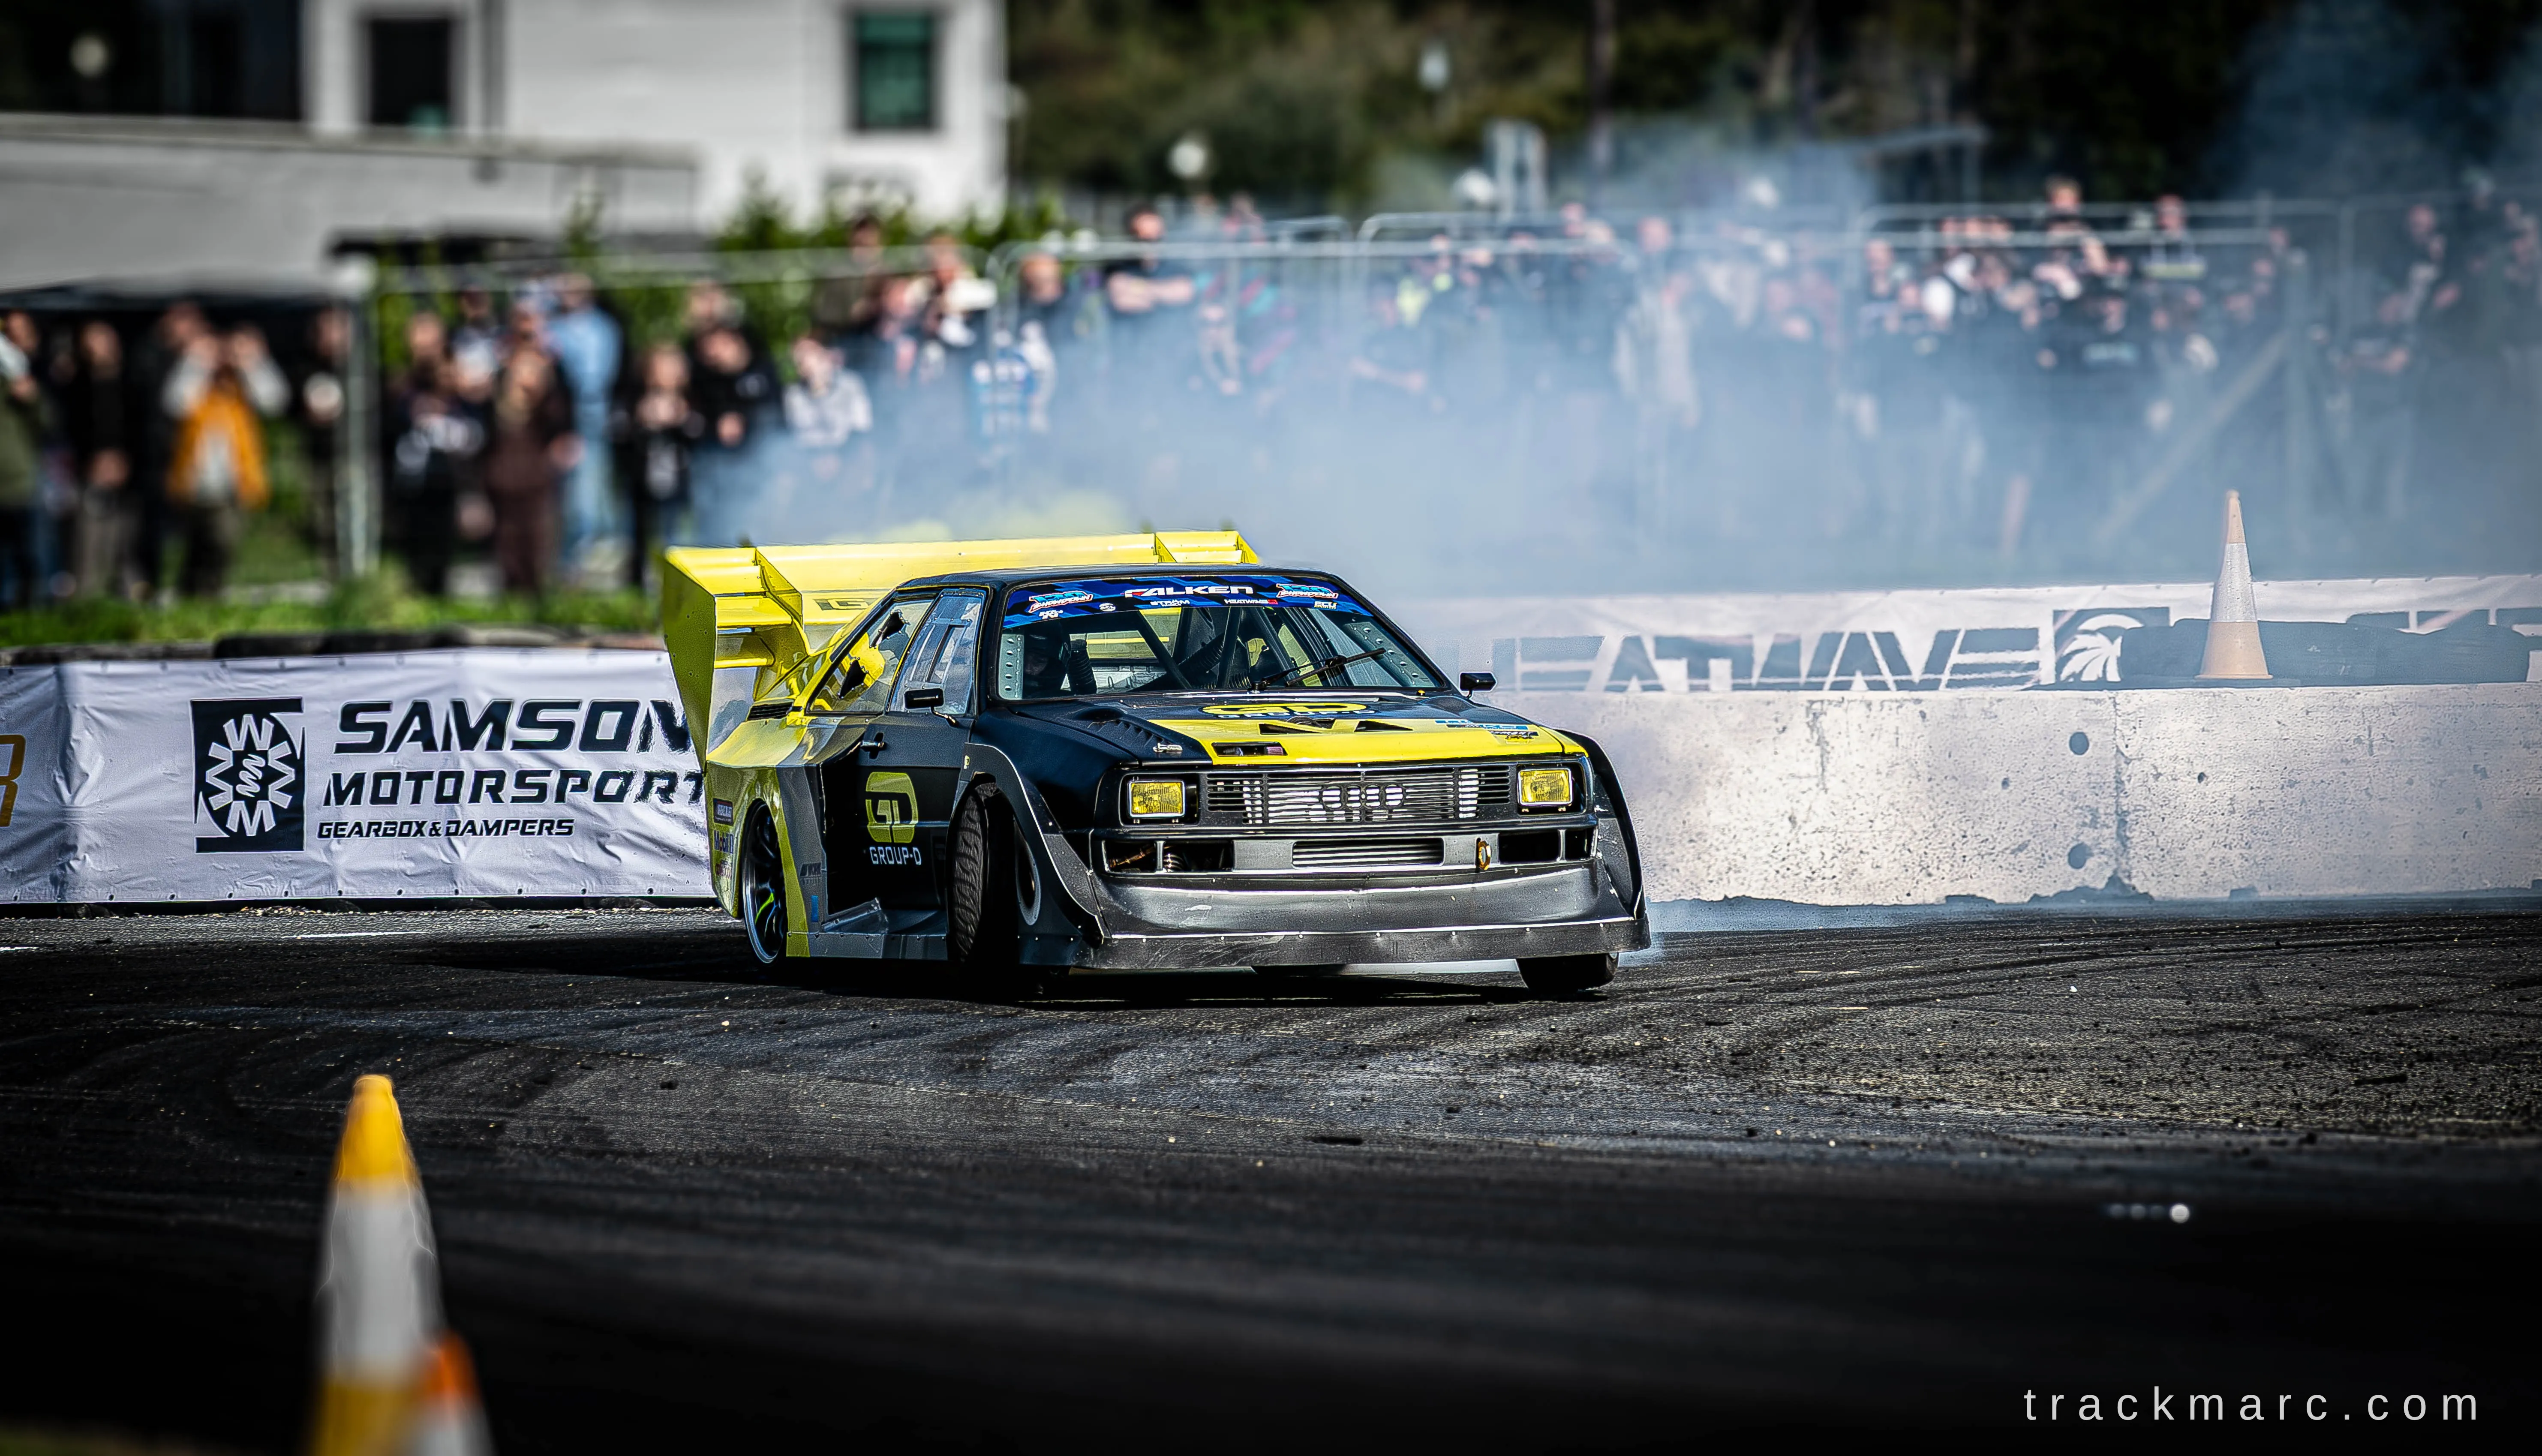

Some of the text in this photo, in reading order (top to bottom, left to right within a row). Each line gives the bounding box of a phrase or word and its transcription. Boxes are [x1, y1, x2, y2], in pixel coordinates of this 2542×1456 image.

[1124, 586, 1253, 598] FALKEN
[1033, 595, 1091, 609] SHOWDOWN
[334, 700, 691, 754] SAMSON
